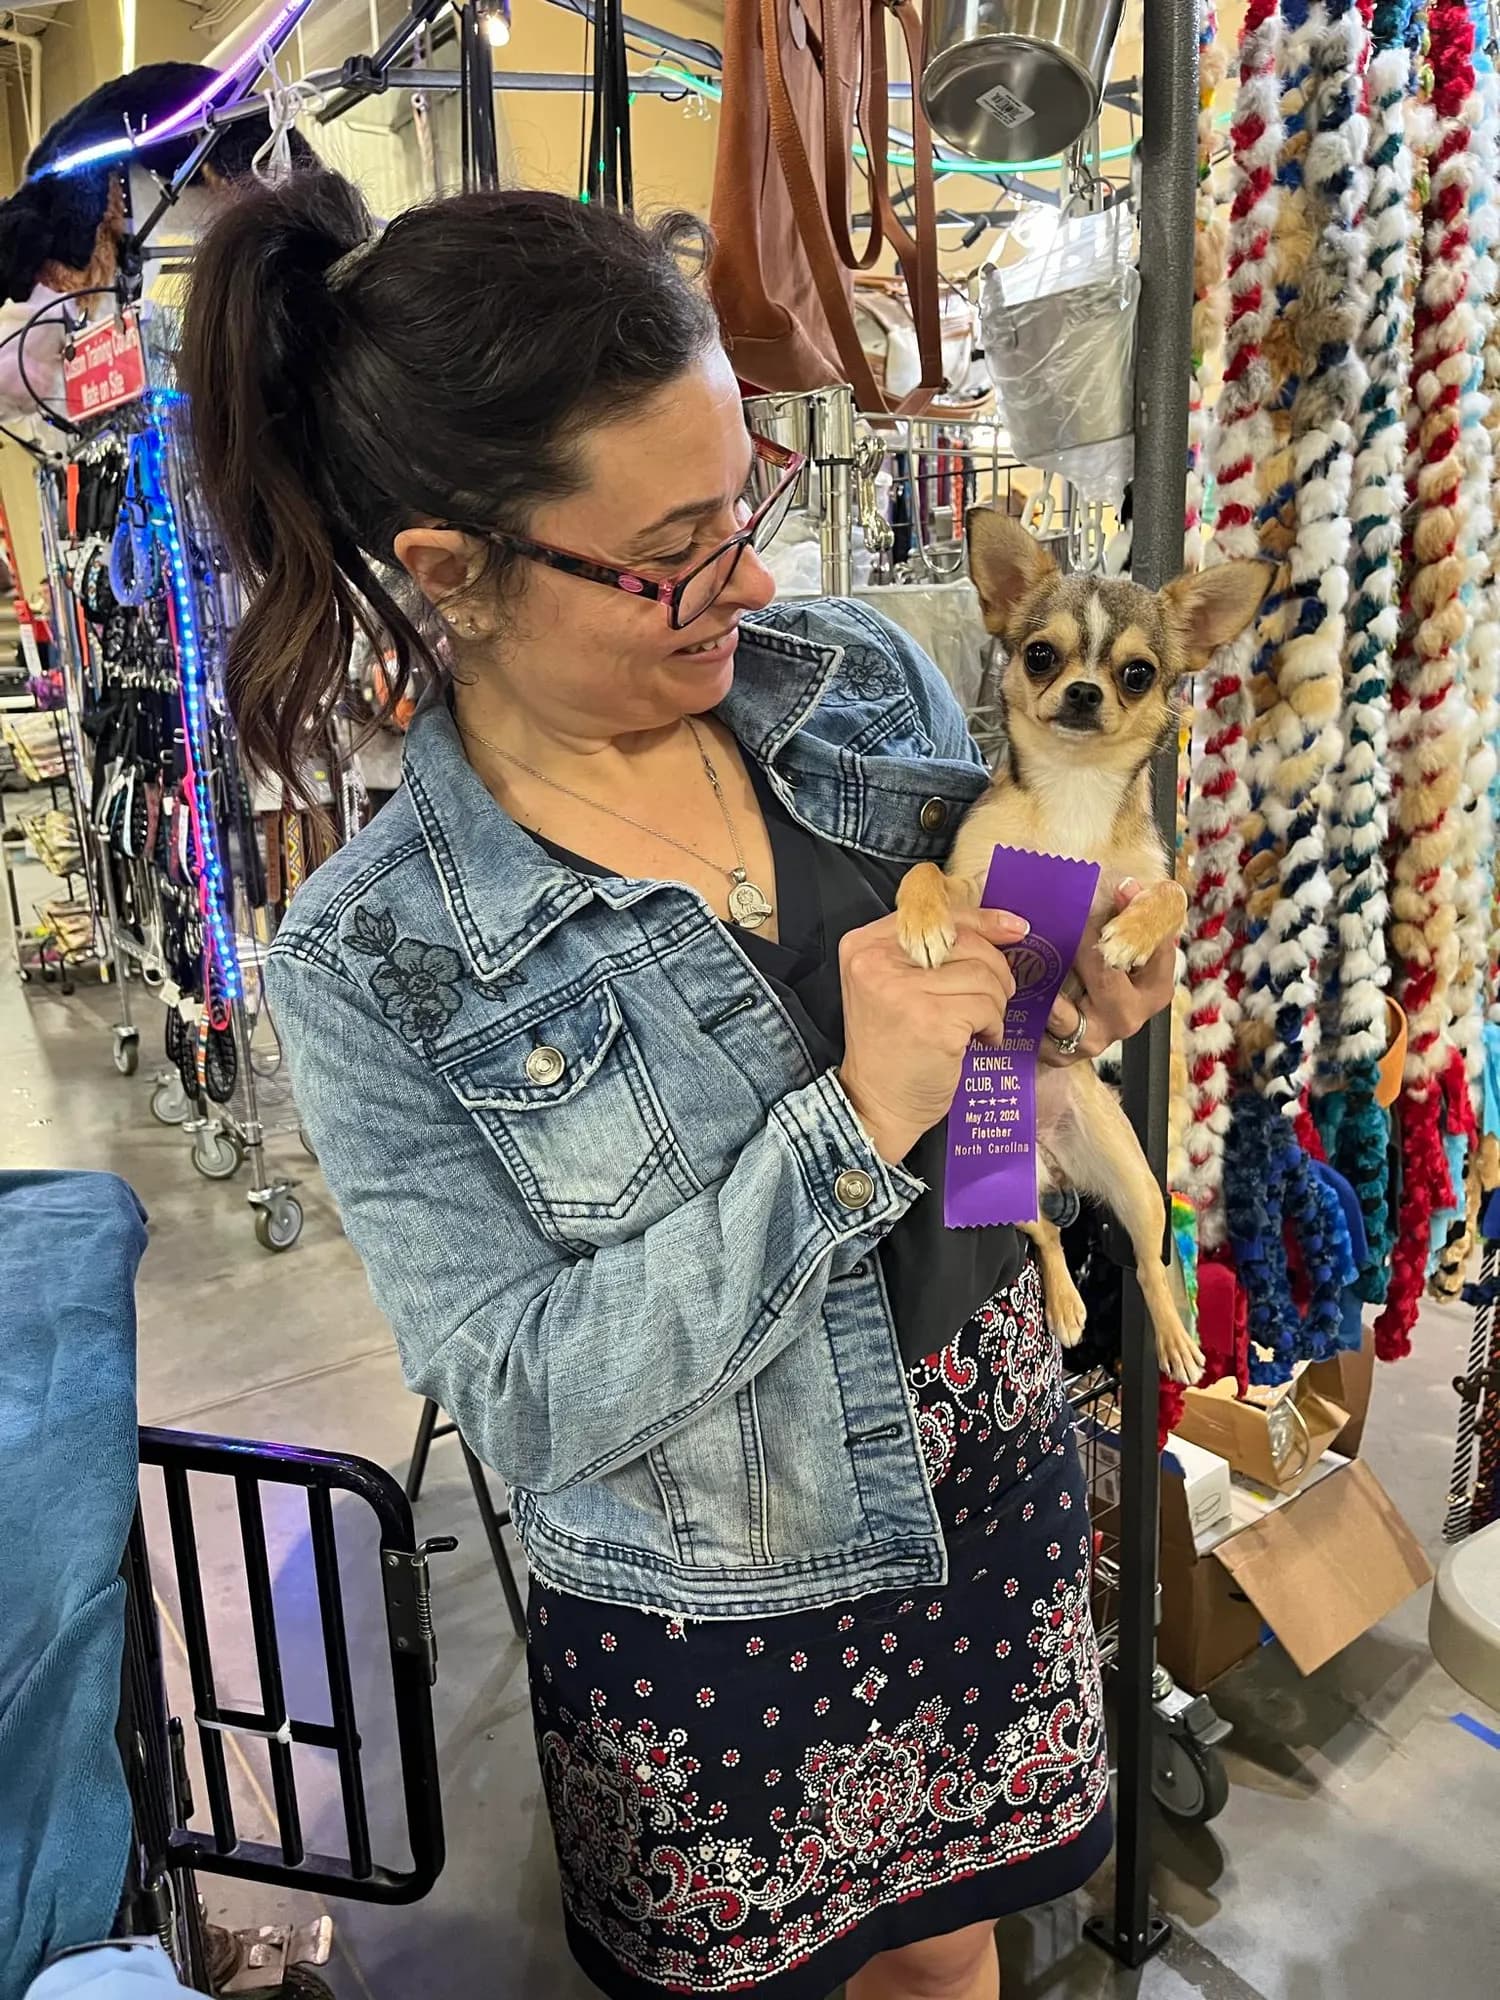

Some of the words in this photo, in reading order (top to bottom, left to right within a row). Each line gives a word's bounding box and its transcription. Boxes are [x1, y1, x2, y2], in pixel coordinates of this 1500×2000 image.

[972, 1056, 1014, 1072] KENNEL
[965, 1076, 994, 1093] CLUB,
[1000, 1075, 1021, 1090] INC.
[965, 1111, 982, 1125] May
[984, 1110, 997, 1123] 27,
[1000, 1109, 1020, 1121] 2024
[971, 1126, 1012, 1139] Fletcher
[954, 1143, 982, 1156] North
[988, 1141, 1029, 1154] Carolina
